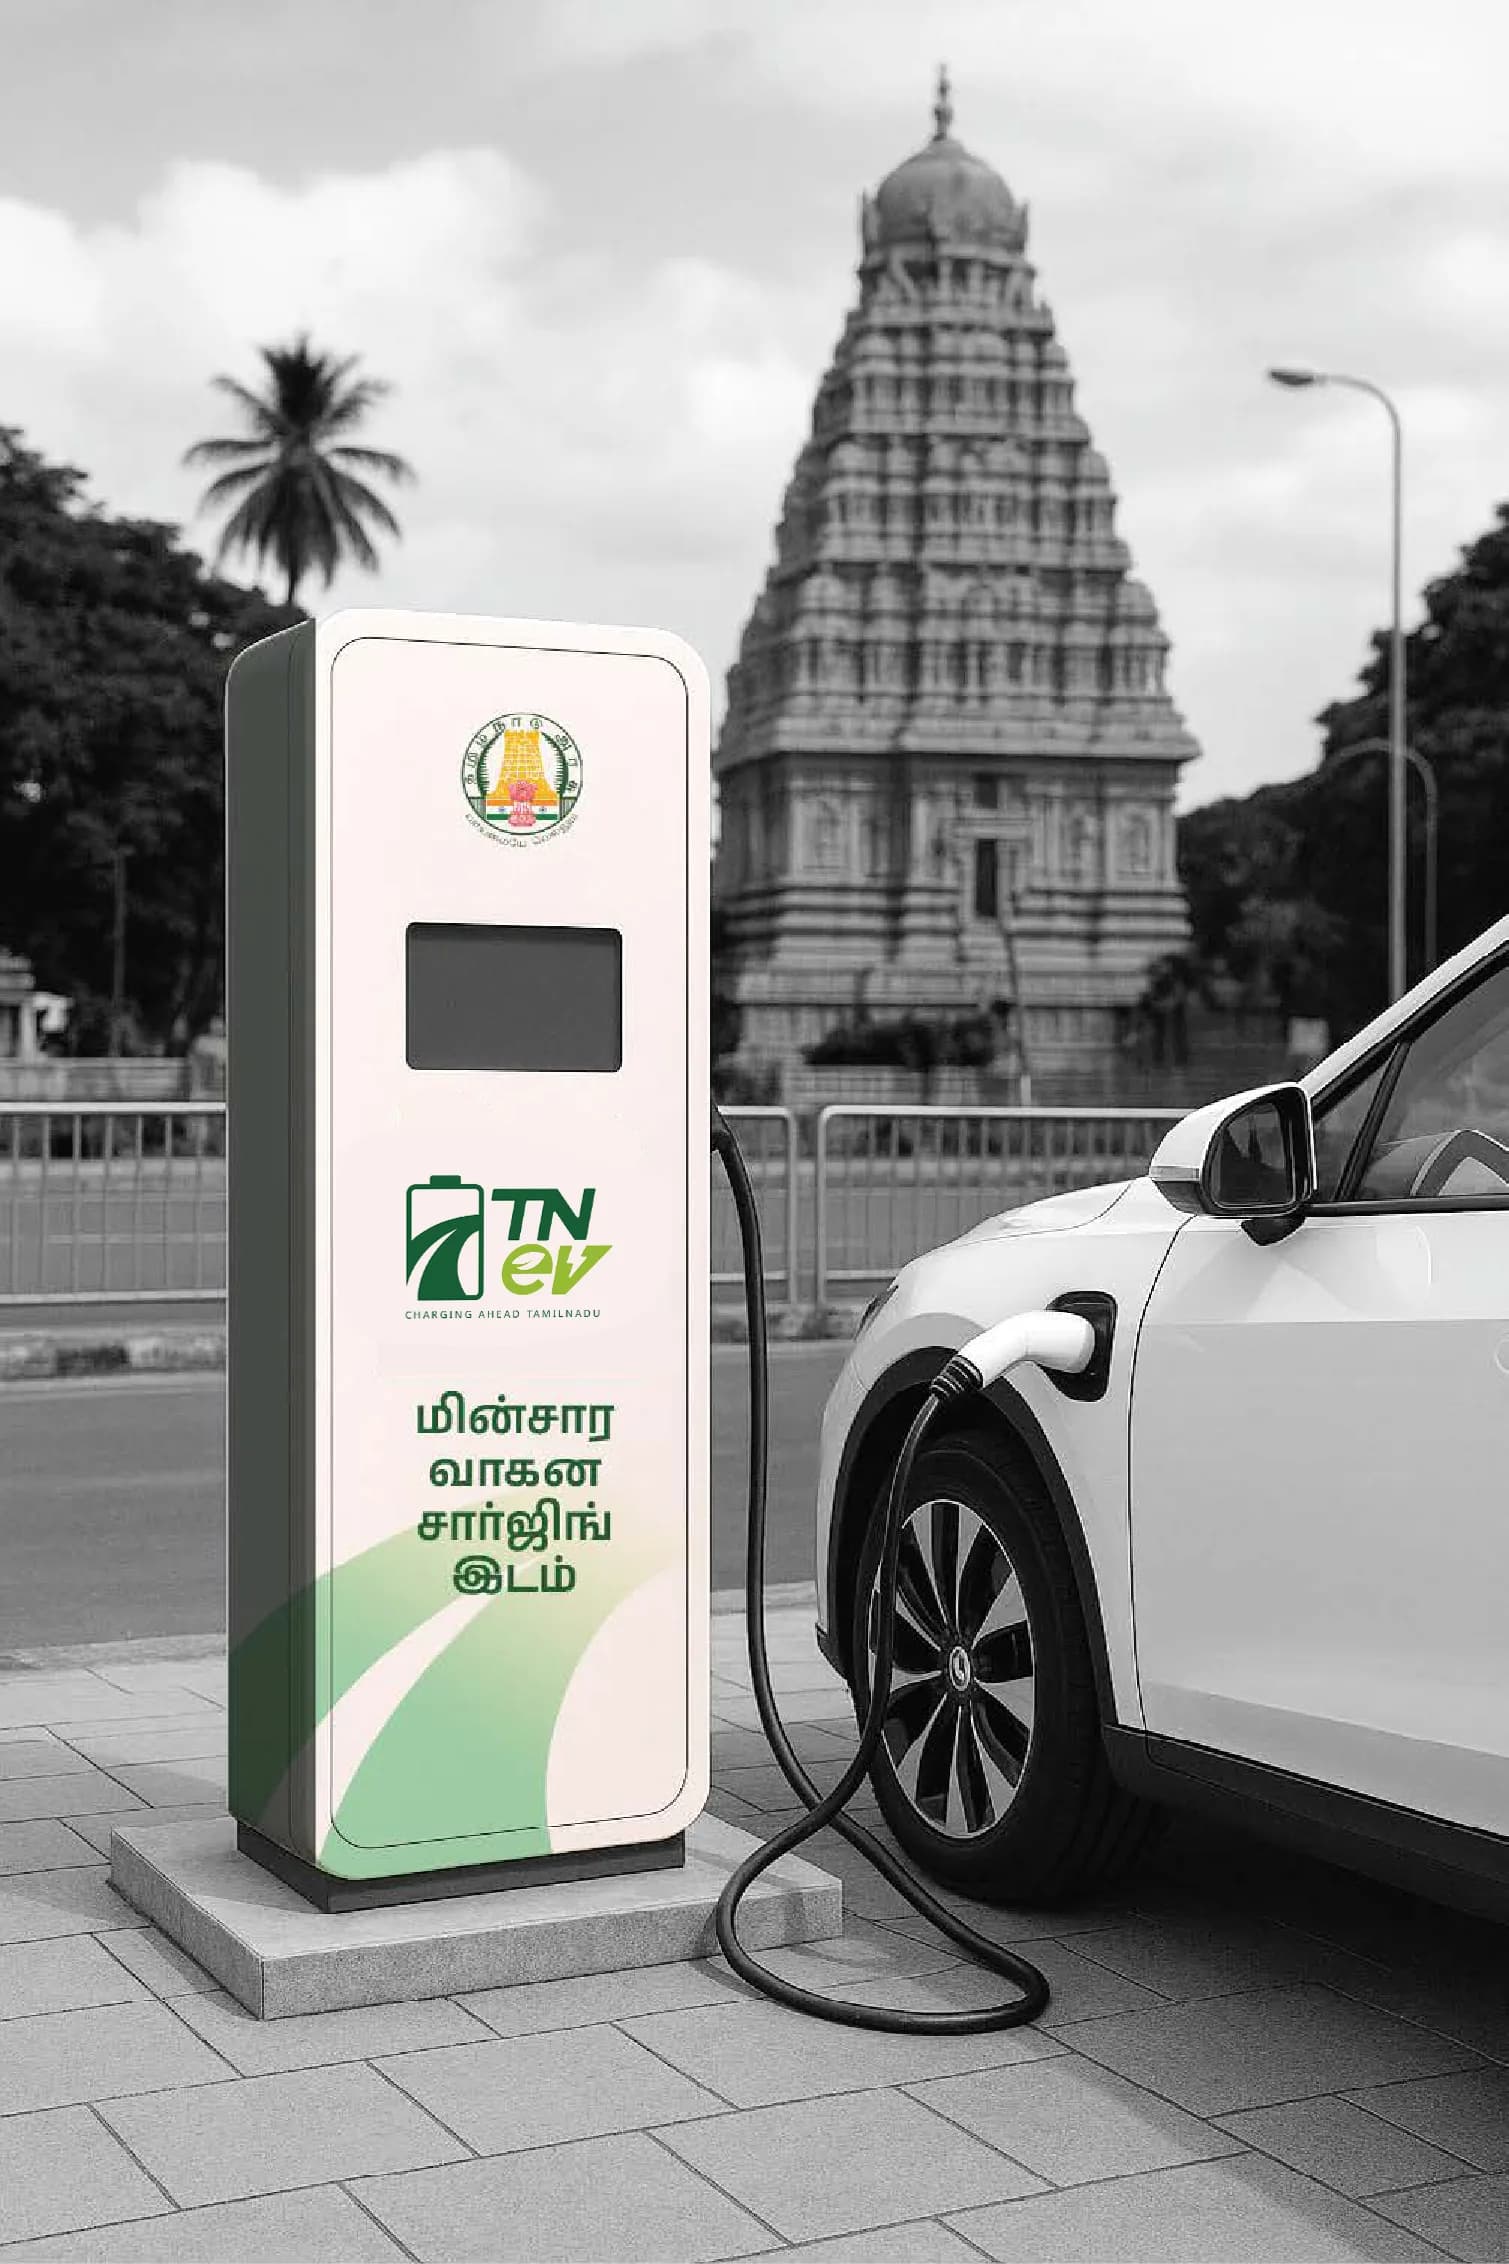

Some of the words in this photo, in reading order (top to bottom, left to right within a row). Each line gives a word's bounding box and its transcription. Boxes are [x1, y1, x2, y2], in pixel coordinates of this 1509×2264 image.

[491, 1187, 596, 1241] TN
[501, 1243, 613, 1295] ev
[404, 1310, 473, 1320] CHARGING
[478, 1309, 520, 1319] AHEAD
[527, 1309, 601, 1318] TAMILNADU
[416, 1390, 614, 1443] மின்சார
[429, 1457, 602, 1488] வாகன
[417, 1497, 611, 1552] சார்ஜிங்
[452, 1554, 576, 1595] இடம்
